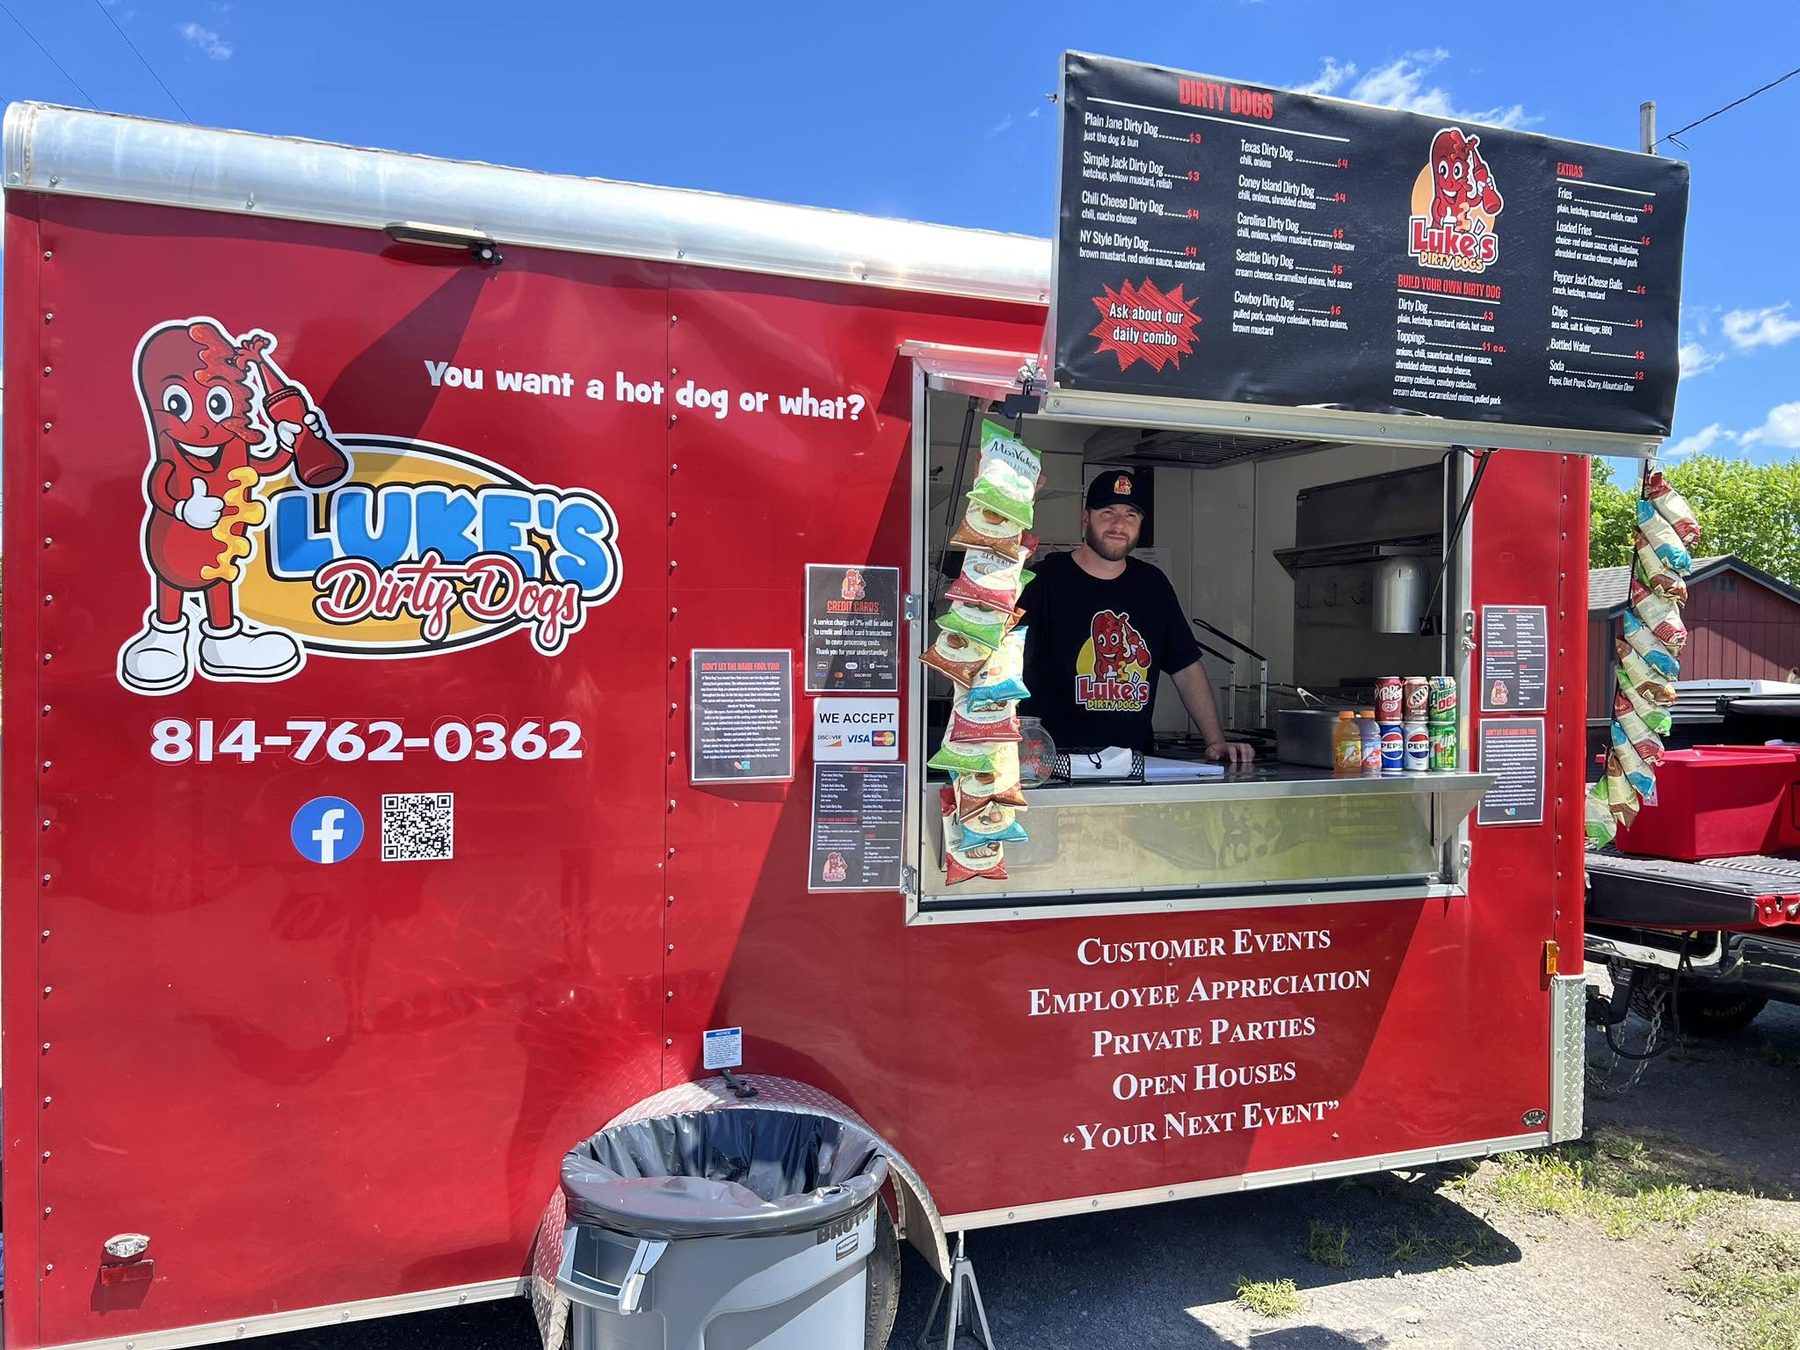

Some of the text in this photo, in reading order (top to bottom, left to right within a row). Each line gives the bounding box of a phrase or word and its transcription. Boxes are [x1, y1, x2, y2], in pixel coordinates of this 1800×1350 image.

[1179, 78, 1274, 120] DIRTY DOGS
[1085, 112, 1159, 138] Plain Jane Dirty Dog
[1084, 130, 1139, 148] just the dog & bun
[1189, 132, 1201, 144] $3
[1241, 139, 1294, 161] Texas Dirty Dog
[1083, 151, 1164, 177] Simple Jack Dirty Dog
[1557, 162, 1583, 178] EXTRAS
[1082, 167, 1173, 189] ketchup, yellow mustard, relish
[1187, 170, 1200, 181] $3
[1238, 174, 1315, 199] Coney Island Dirty Dog
[1082, 190, 1165, 216] Chili Cheese Dirty Dog
[1558, 187, 1573, 200] Fries
[1187, 208, 1200, 220] $4
[1237, 212, 1300, 234] Carolina Dirty Dog
[1411, 219, 1496, 258] Luke's
[1556, 220, 1592, 236] Loaded Fries
[1080, 229, 1149, 252] NY Style Dirty Dog
[1185, 246, 1197, 257] $4
[1079, 247, 1205, 271] brown mustard, red onion sauce, sauerkraut
[1236, 249, 1295, 270] Seattle Dirty Dog
[1420, 249, 1484, 271] DIRTY DOGS
[1235, 268, 1353, 290] cream cheese, caramelized onions, hot sauce
[1398, 273, 1501, 299] BUILD YOUR OWN DIRTY DOG
[1553, 270, 1623, 291] Pepper Jack Cheese Balls
[1234, 291, 1295, 311] Cowboy Dirty Dog
[1398, 298, 1428, 314] Dirty Dog
[1551, 305, 1569, 319] Chips
[1109, 303, 1184, 324] Ask about our
[1233, 309, 1349, 331] pulled pork, cowboy coleslaw, french onions,
[1113, 326, 1177, 346] daily combo
[1232, 322, 1274, 336] brown mustard
[1397, 330, 1426, 345] Toppings
[1551, 338, 1591, 353] Bottled Water
[1549, 359, 1565, 372] Soda
[424, 359, 865, 421] You want a hot dog or what?
[272, 488, 612, 592] LUKE'S
[316, 554, 581, 646] Dirty Dogs
[827, 600, 880, 612] CREDIT CARDS
[1076, 672, 1149, 704] Luke's
[1086, 699, 1141, 711] DIRTY DOGS
[819, 713, 895, 724] WE ACCEPT
[150, 719, 583, 764] 814-762-0362
[848, 734, 870, 743] VISA
[1076, 928, 1331, 967] CUSTOMER EVENTS
[1028, 969, 1371, 1016] EMPLOYEE APPRECIATION
[1092, 1016, 1316, 1058] PRIVATE PARTIES
[1112, 1061, 1296, 1101] OPEN HOUSES
